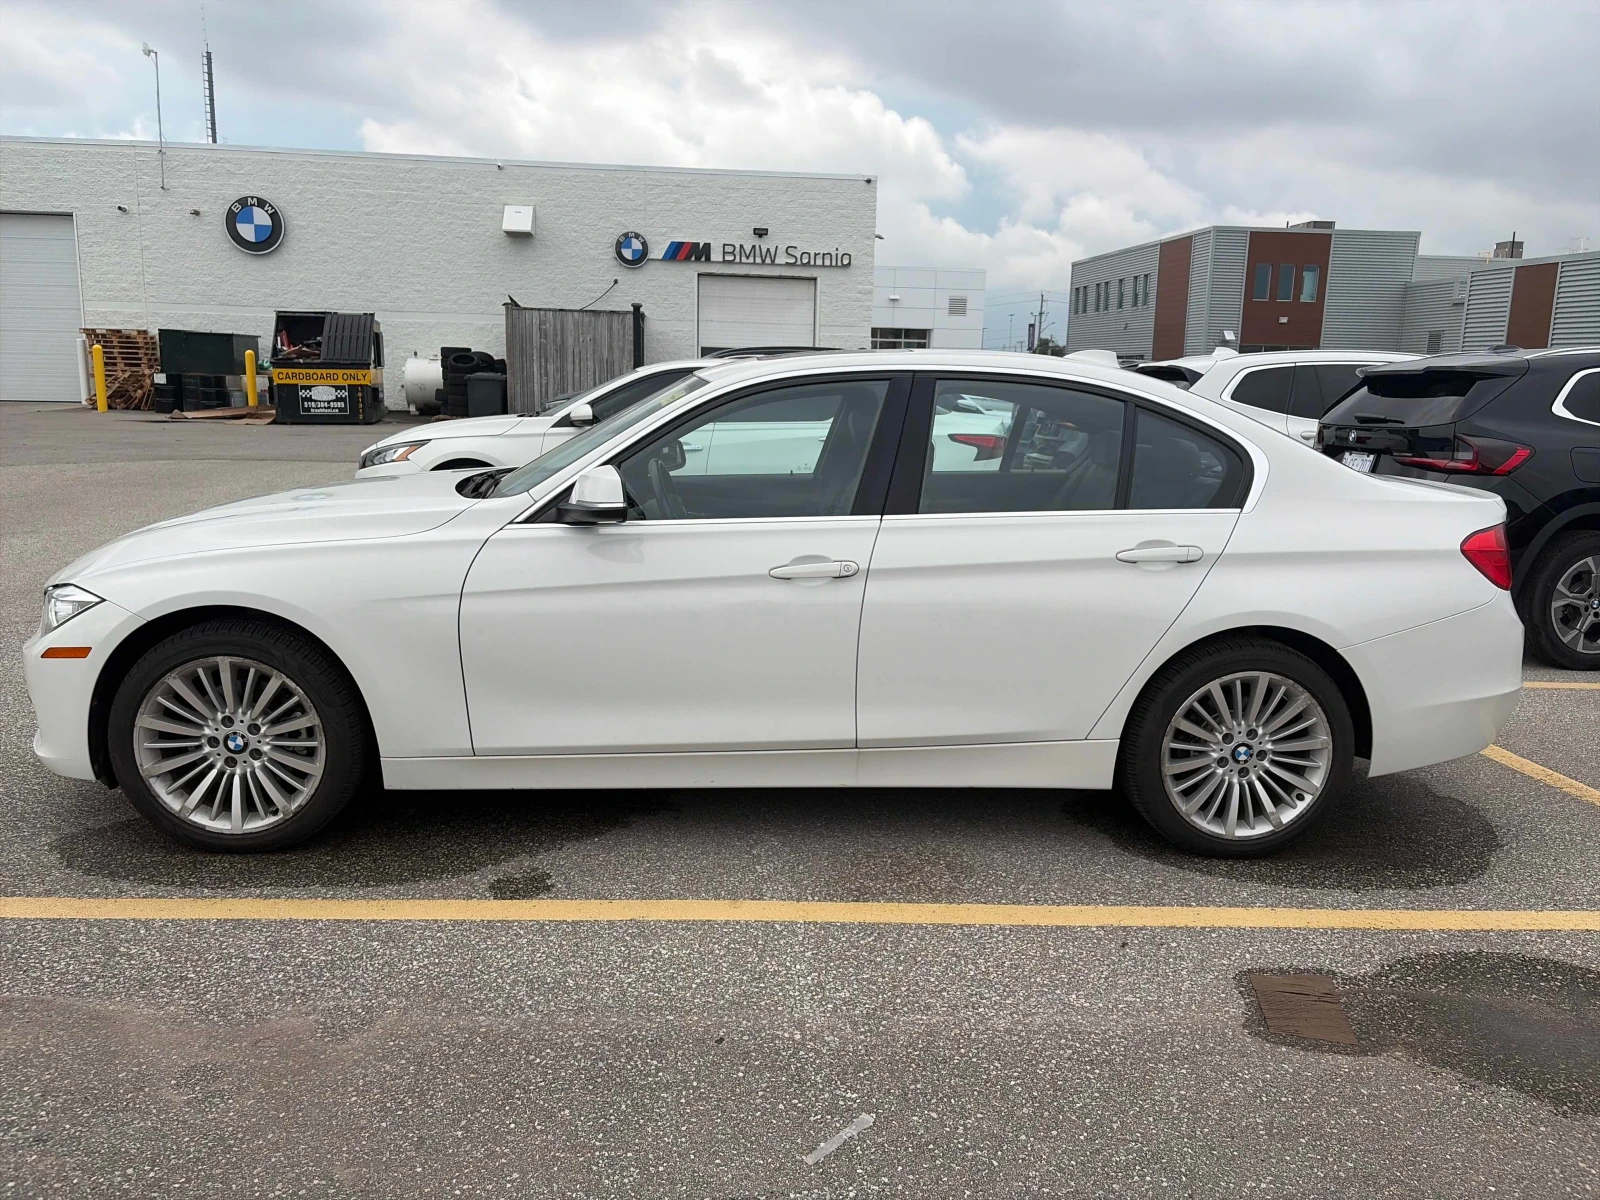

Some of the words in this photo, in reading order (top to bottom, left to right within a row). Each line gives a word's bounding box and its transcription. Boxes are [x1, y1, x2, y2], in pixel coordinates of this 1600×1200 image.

[231, 197, 275, 215] BMW
[619, 232, 645, 243] BMW
[722, 243, 778, 264] BMW
[785, 245, 852, 267] Sarnia
[277, 372, 339, 381] CARDBOARD
[341, 372, 368, 382] ONLY
